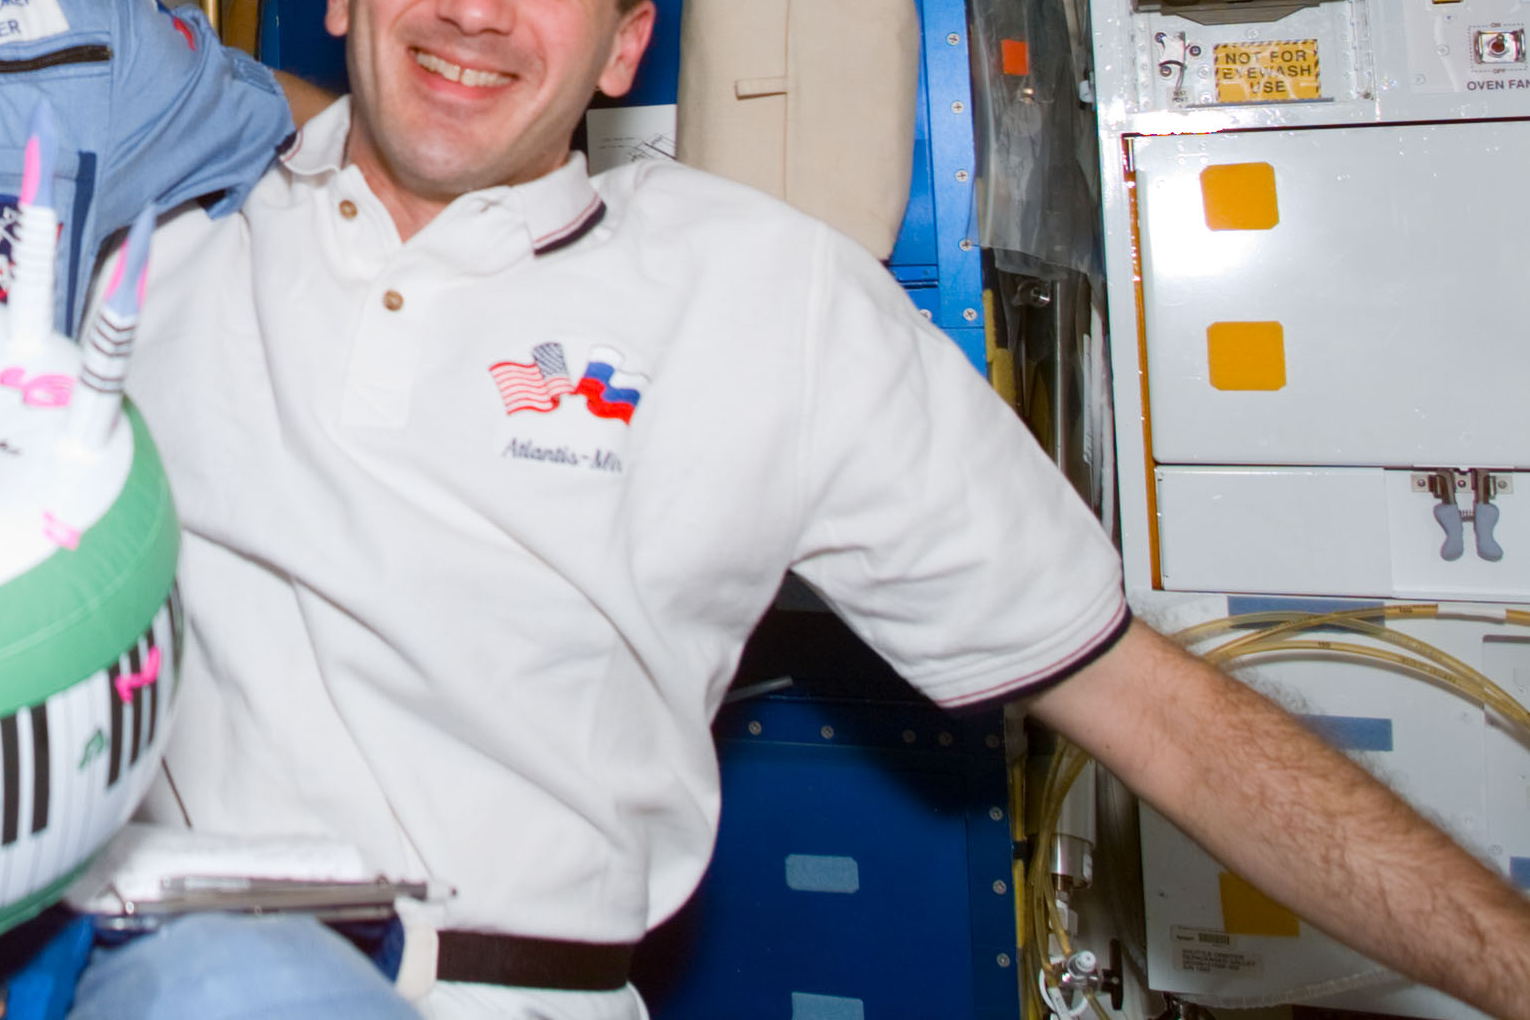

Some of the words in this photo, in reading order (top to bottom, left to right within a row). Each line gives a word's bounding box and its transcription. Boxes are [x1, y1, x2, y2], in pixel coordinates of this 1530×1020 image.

[1225, 51, 1262, 65] NOT
[1271, 49, 1308, 63] FOR
[1223, 65, 1312, 81] EYEWASH
[1250, 80, 1287, 94] USE
[1467, 79, 1505, 91] OVEN
